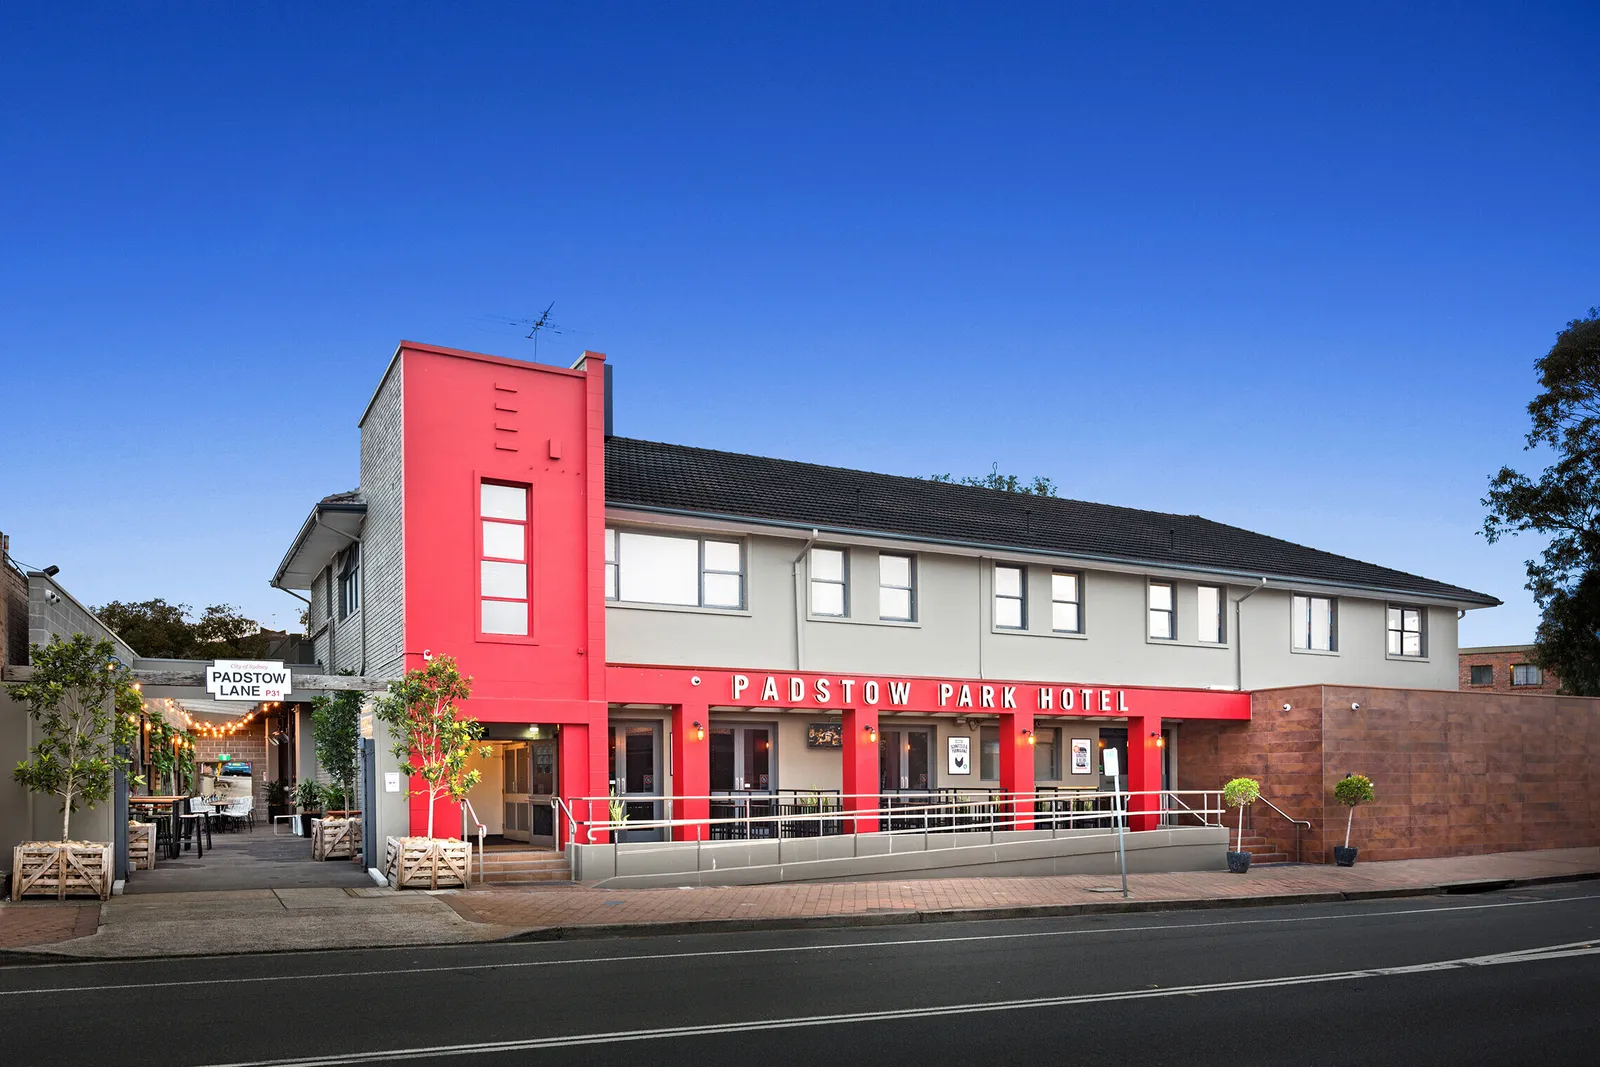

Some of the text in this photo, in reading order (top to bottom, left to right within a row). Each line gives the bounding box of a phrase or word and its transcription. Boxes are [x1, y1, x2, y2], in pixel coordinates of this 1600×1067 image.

[213, 672, 286, 684] PADSTOW
[220, 685, 261, 696] LANE
[732, 674, 1129, 712] PADSTOW PARK HOTEL
